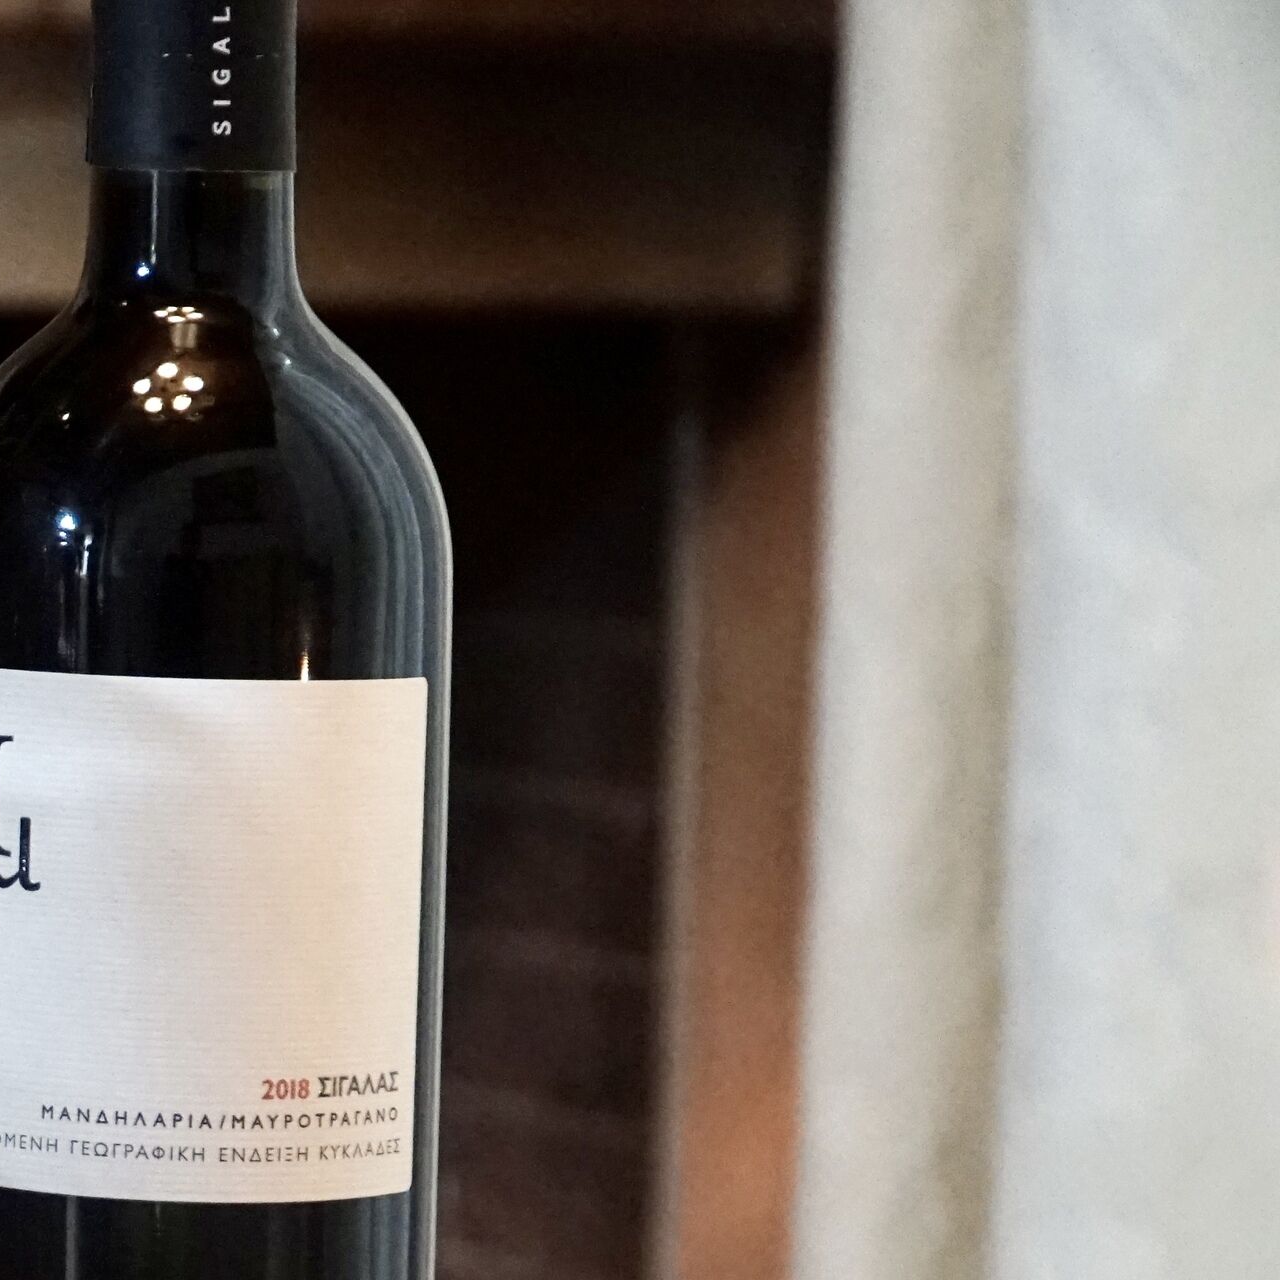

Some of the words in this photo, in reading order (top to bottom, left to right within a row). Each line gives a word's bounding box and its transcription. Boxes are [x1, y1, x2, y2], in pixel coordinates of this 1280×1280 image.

[261, 1078, 310, 1101] 2018
[317, 1071, 400, 1099] ΣΙΓΑΛΑΣ
[69, 1139, 206, 1163] ΓΕΩΓΡΑΦΙΚΗ
[218, 1146, 309, 1163] ΕΝΔΕΙΞΗ
[318, 1138, 401, 1161] ΚΥΚΛΑΔΕΣ
